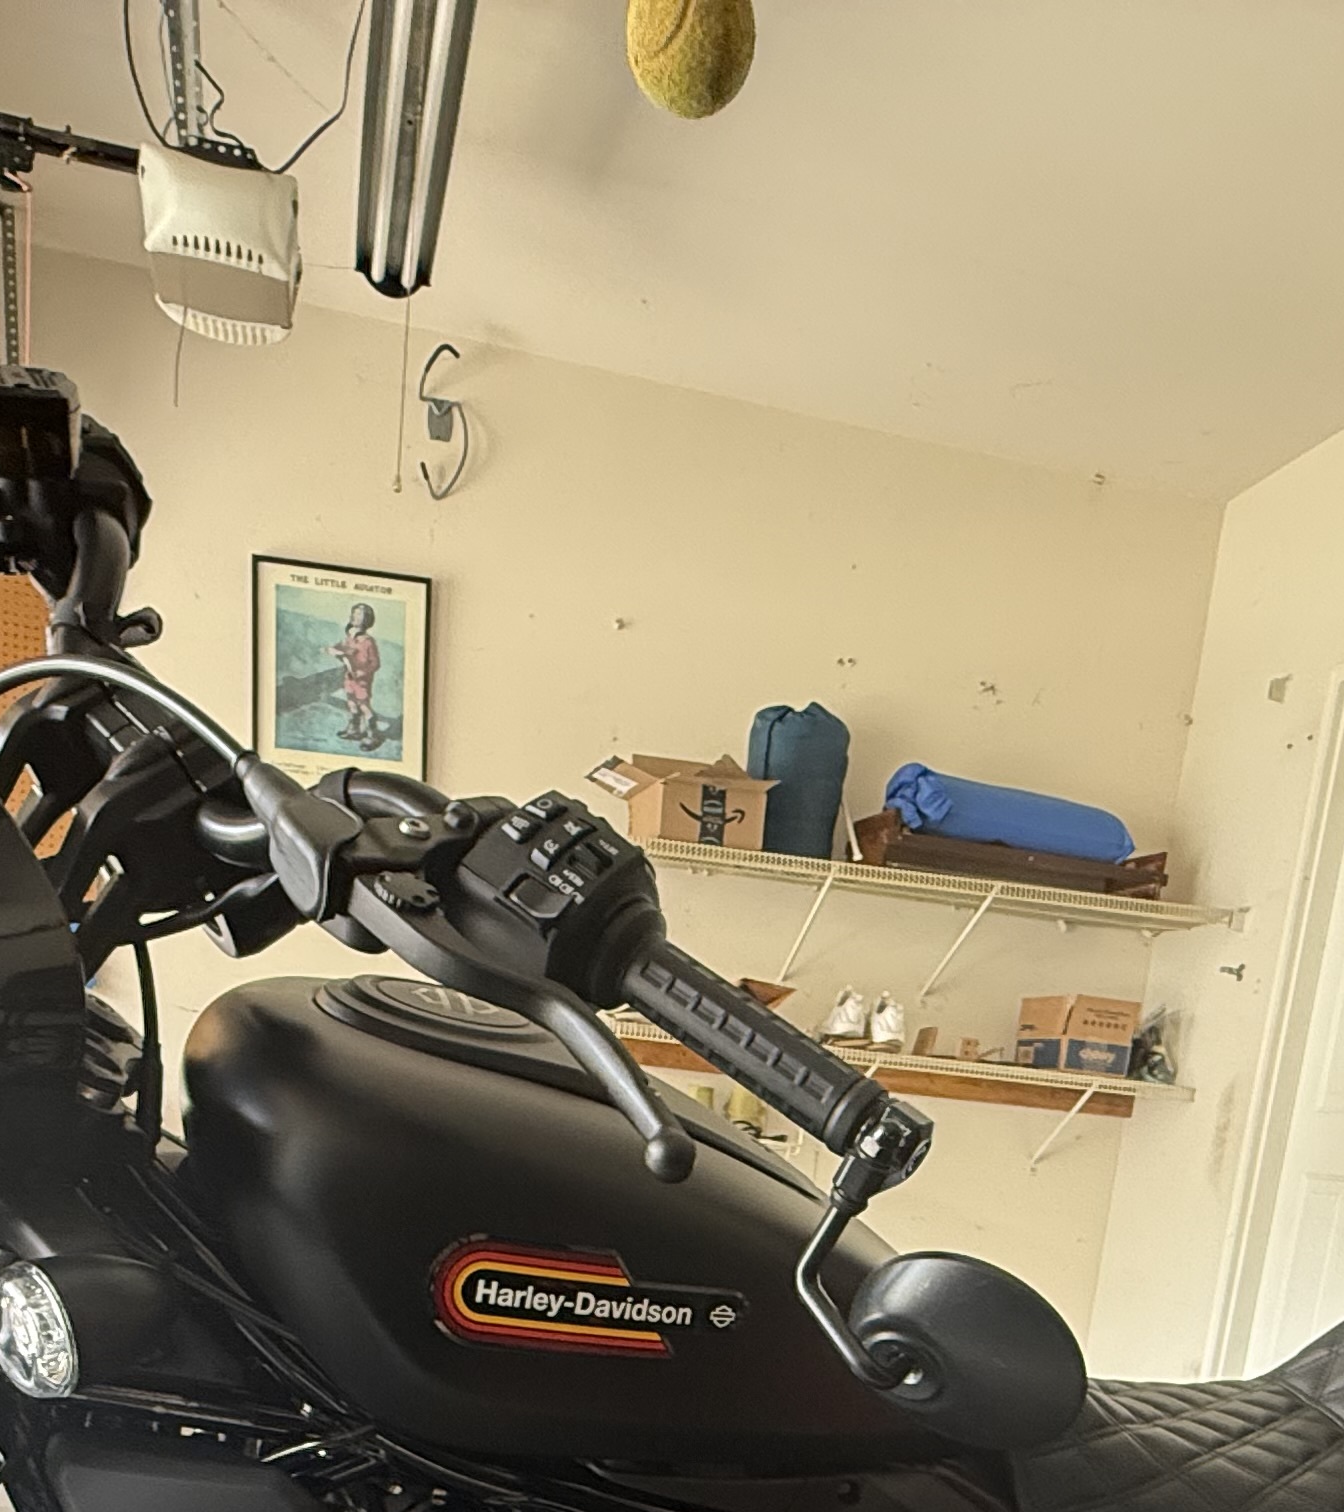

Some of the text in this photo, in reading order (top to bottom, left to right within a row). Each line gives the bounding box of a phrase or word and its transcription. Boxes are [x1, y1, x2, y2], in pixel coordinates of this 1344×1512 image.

[290, 574, 309, 584] THE
[314, 577, 347, 589] LITTLE
[474, 1278, 693, 1326] Harley-Davidson
